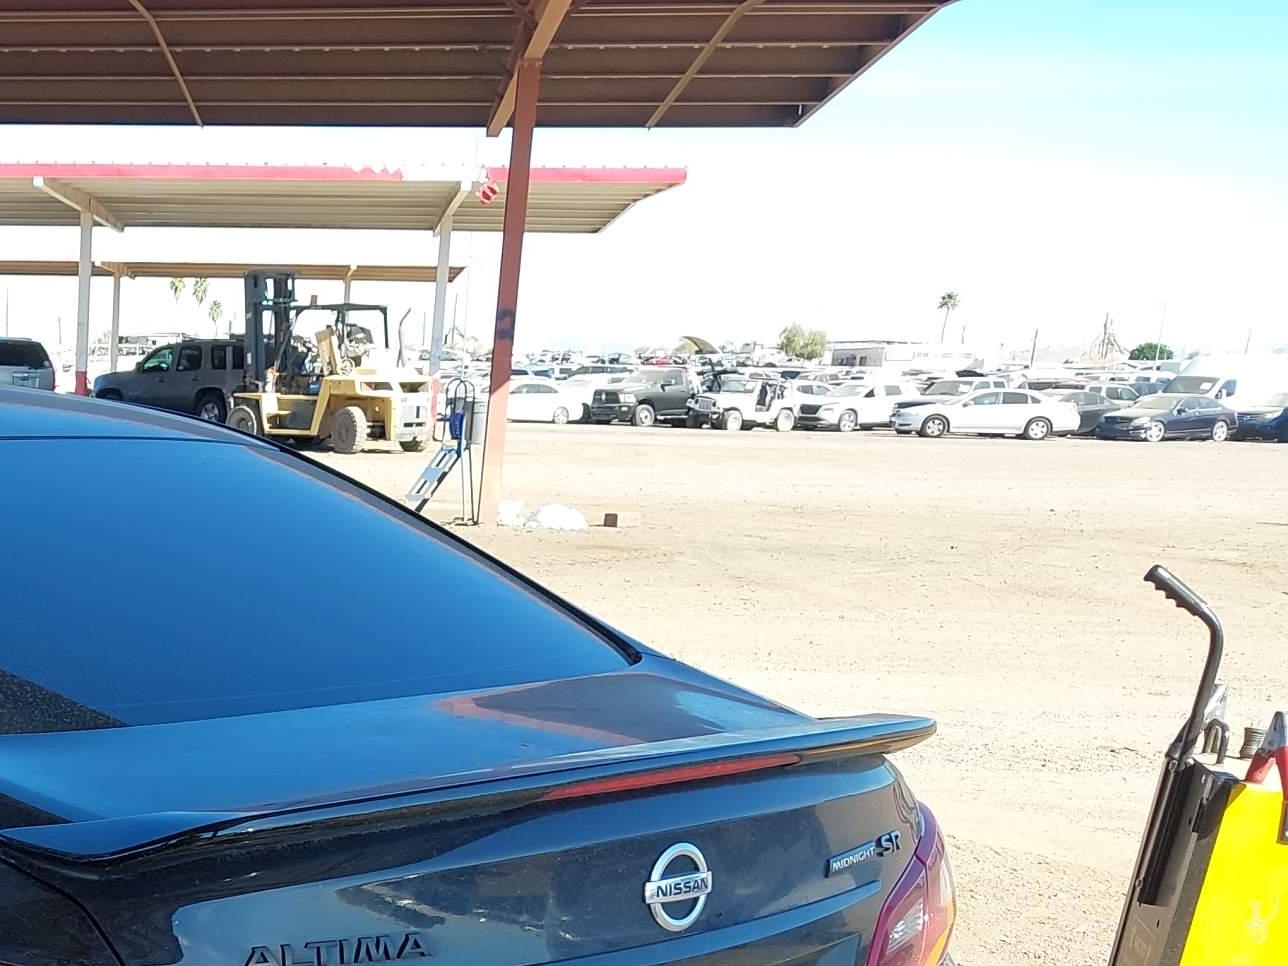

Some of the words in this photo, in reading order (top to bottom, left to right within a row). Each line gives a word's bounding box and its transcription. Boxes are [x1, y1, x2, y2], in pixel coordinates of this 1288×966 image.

[832, 847, 875, 872] MIDNIGHT
[879, 830, 901, 855] SR
[655, 876, 709, 898] NISSAN
